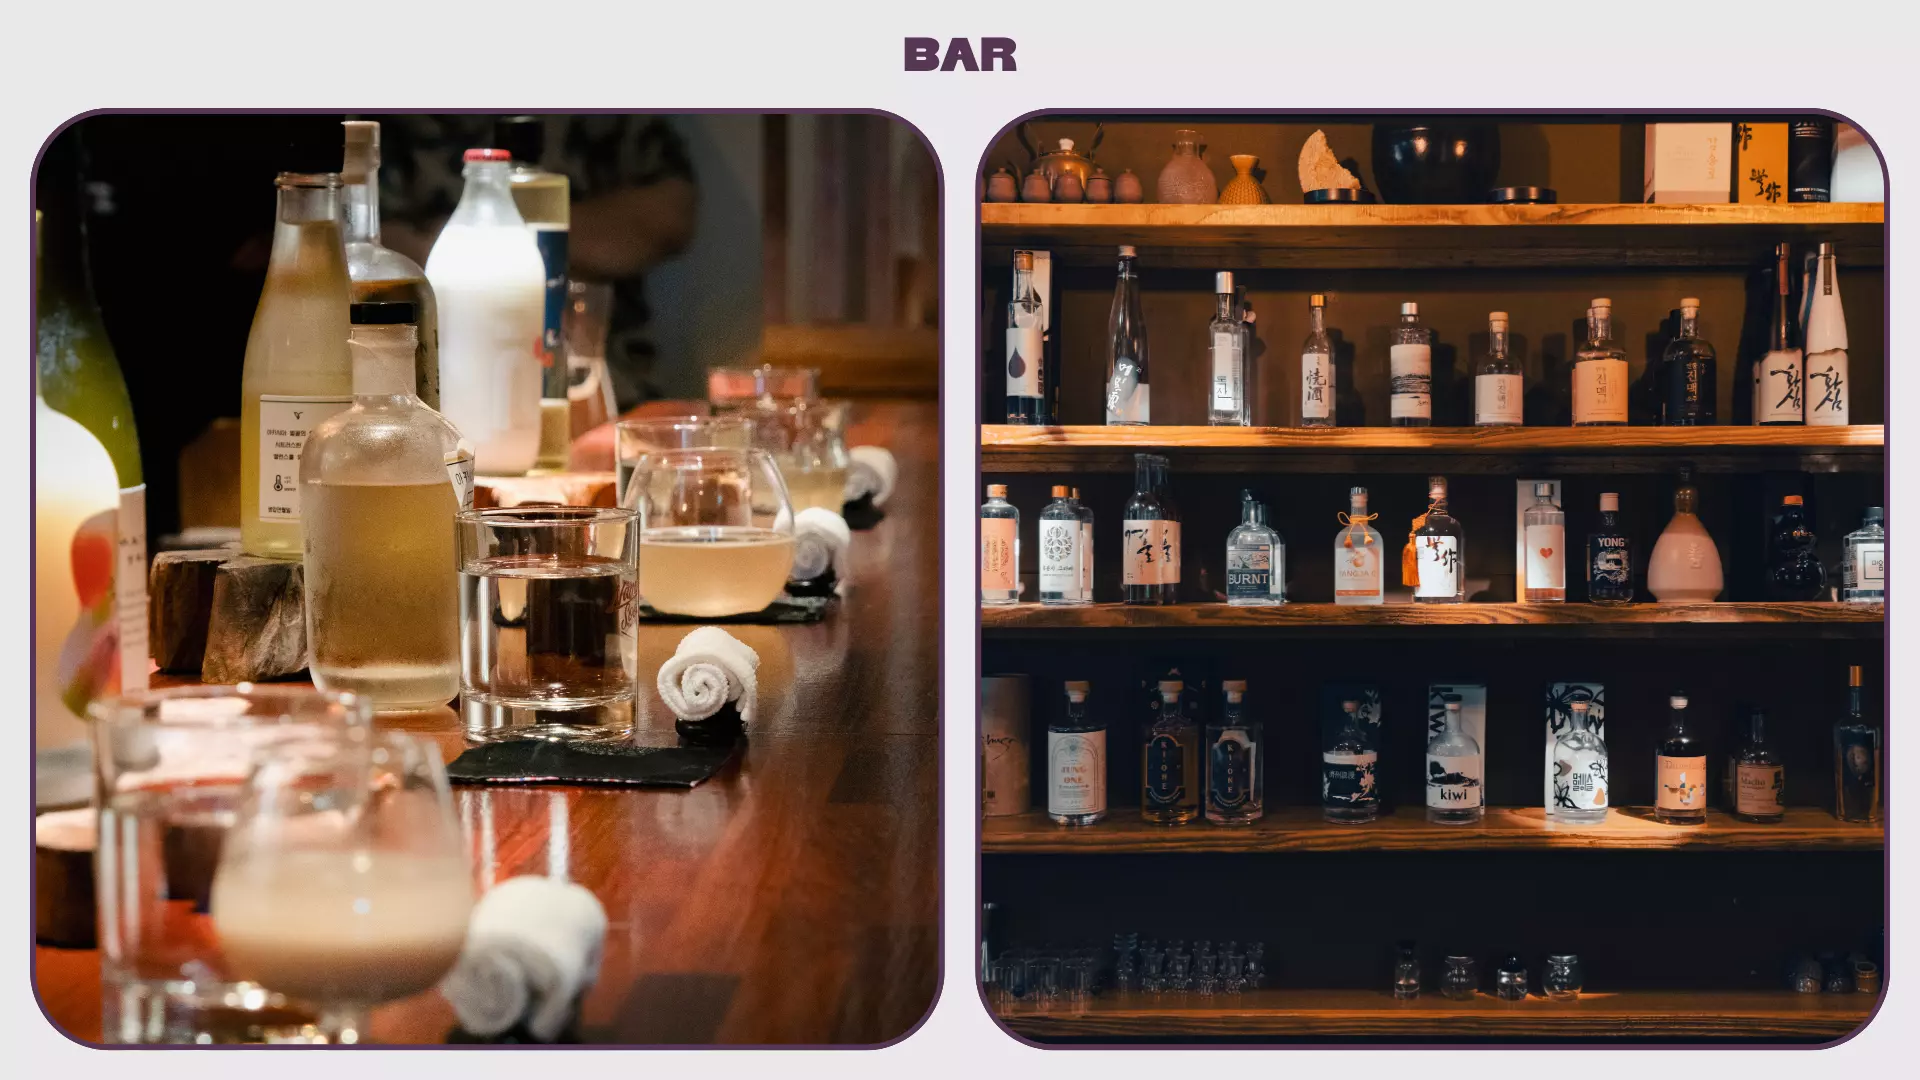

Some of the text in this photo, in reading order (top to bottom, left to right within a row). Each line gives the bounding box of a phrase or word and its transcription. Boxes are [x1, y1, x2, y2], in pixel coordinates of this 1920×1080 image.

[1597, 537, 1626, 548] YONG
[1228, 573, 1269, 585] BURNT
[1063, 776, 1083, 784] ONE
[1440, 787, 1467, 801] kiwi
